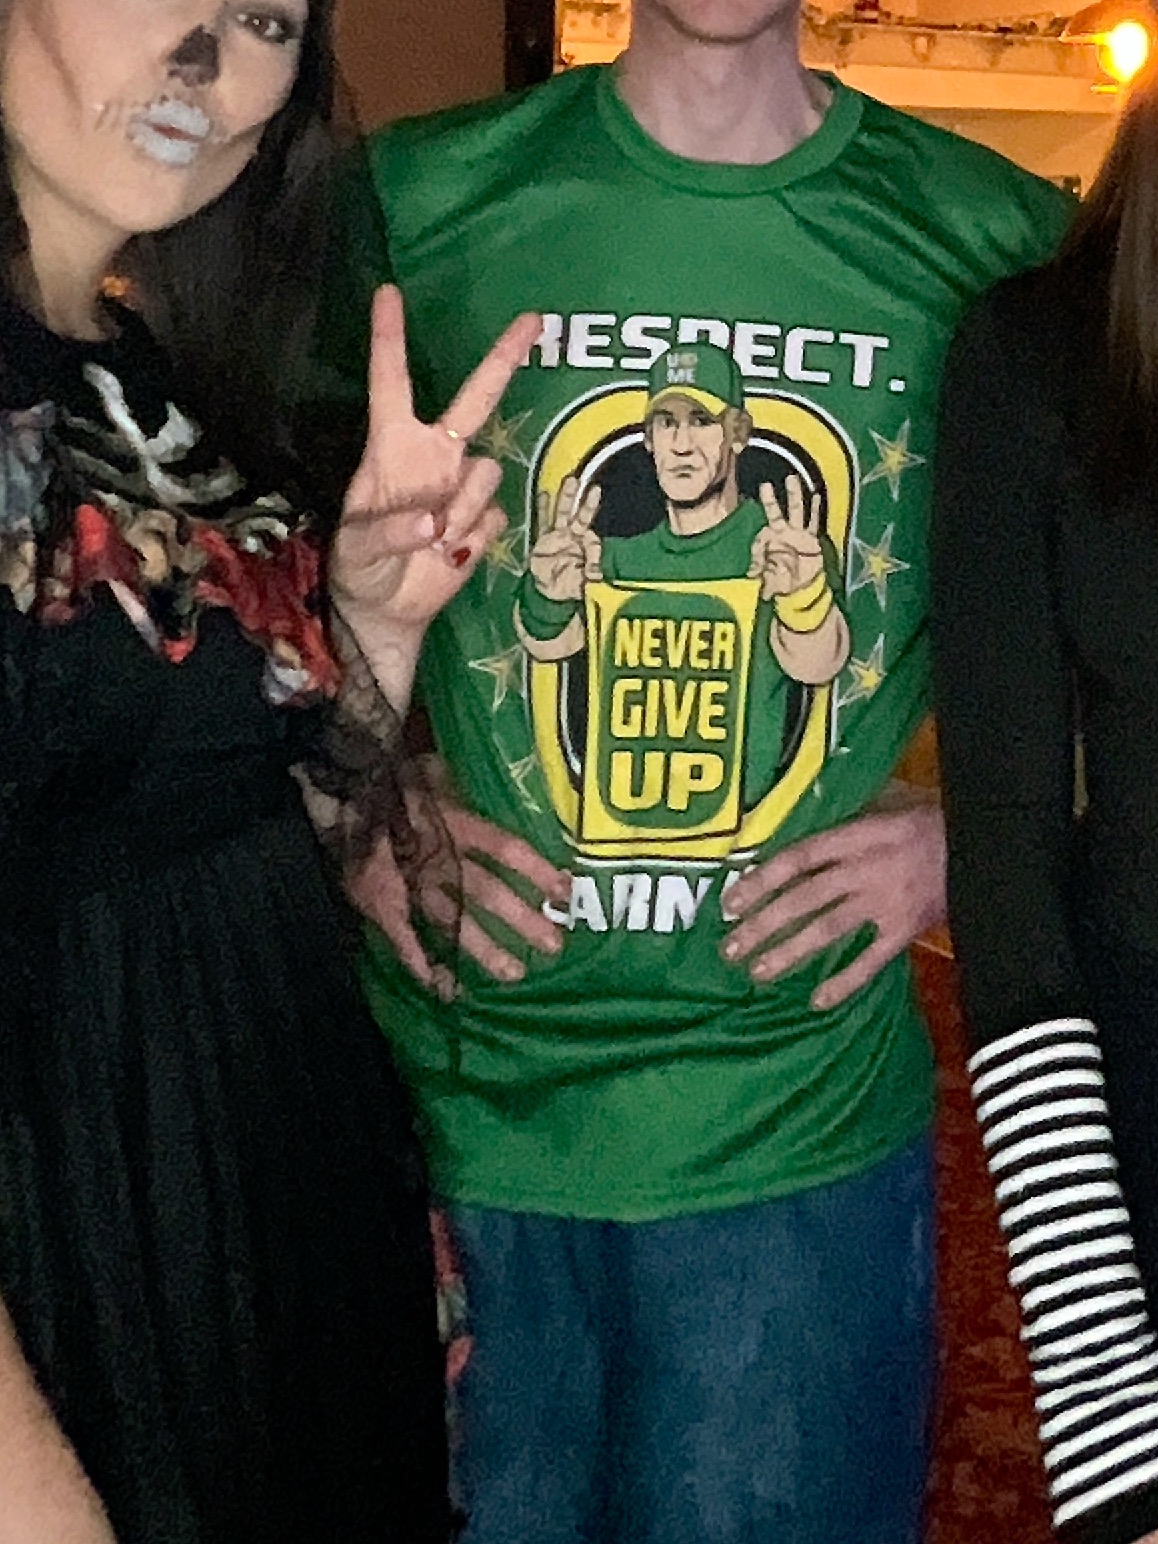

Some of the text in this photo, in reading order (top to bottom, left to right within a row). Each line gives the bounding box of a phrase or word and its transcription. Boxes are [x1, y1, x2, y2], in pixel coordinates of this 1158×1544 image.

[667, 367, 696, 384] ME
[614, 618, 735, 670] NEVER
[611, 678, 729, 740] GIVE
[610, 750, 724, 811] UP
